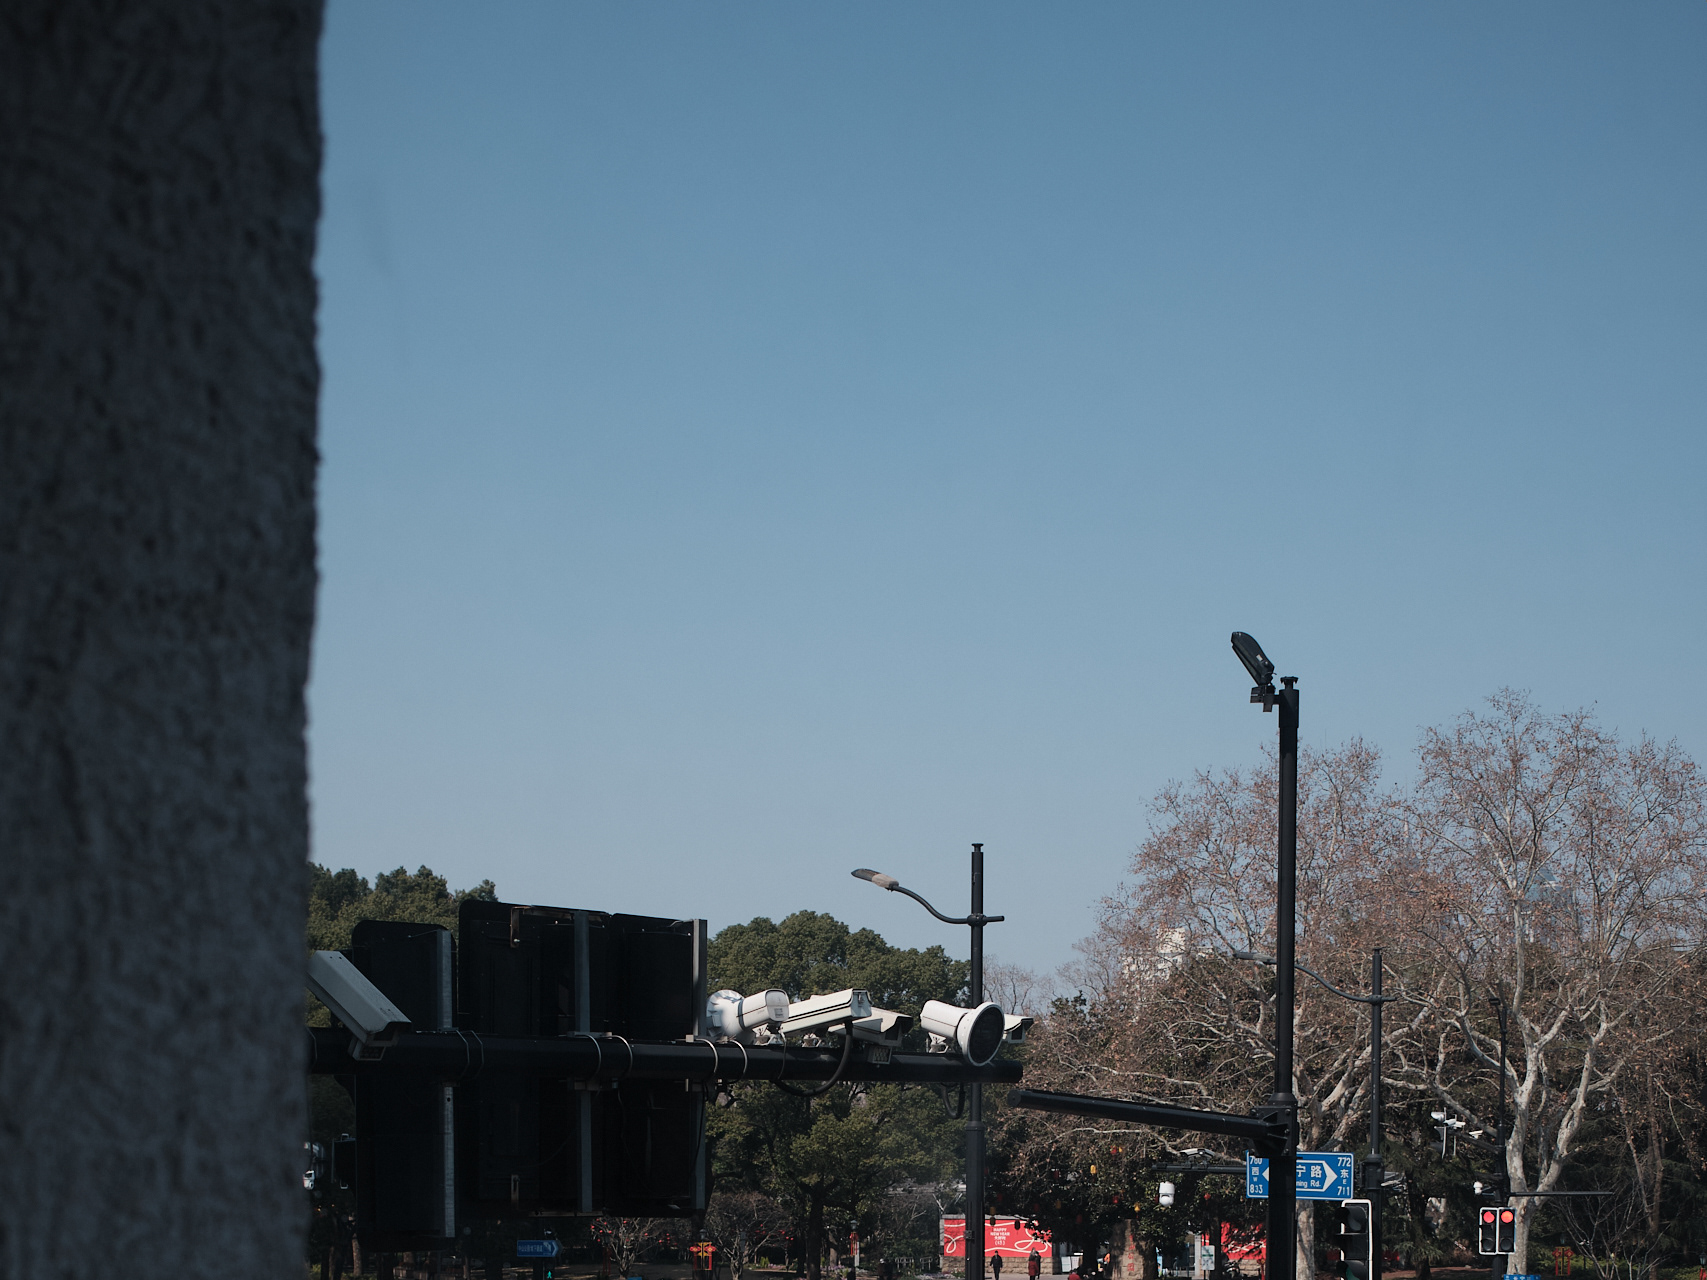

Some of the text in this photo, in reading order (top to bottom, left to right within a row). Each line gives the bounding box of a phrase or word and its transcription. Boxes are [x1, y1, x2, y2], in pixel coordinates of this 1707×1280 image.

[1337, 1157, 1351, 1167] 772
[1251, 1166, 1260, 1176] 西
[1296, 1164, 1322, 1178] 宁路
[1340, 1169, 1349, 1178] 东
[1250, 1184, 1264, 1194] 833
[1296, 1180, 1308, 1189] ning
[1337, 1186, 1350, 1196] 711
